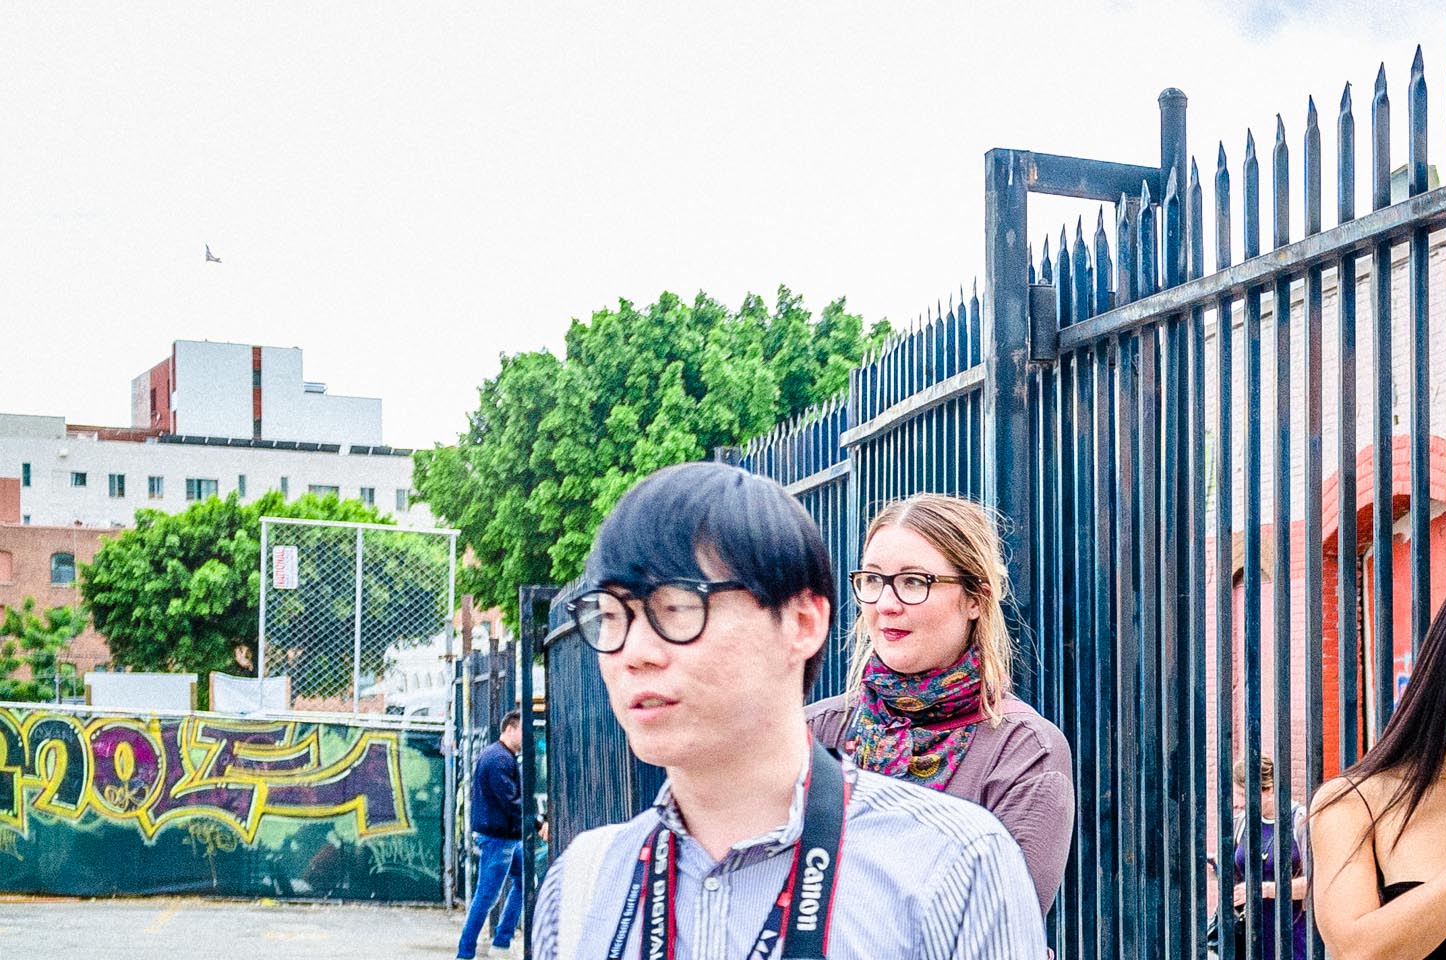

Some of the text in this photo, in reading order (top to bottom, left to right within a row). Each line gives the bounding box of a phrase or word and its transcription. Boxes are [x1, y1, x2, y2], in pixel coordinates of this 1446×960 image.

[655, 829, 670, 875] EOS
[796, 847, 830, 931] Canon
[609, 883, 641, 959] Microsoft Surface
